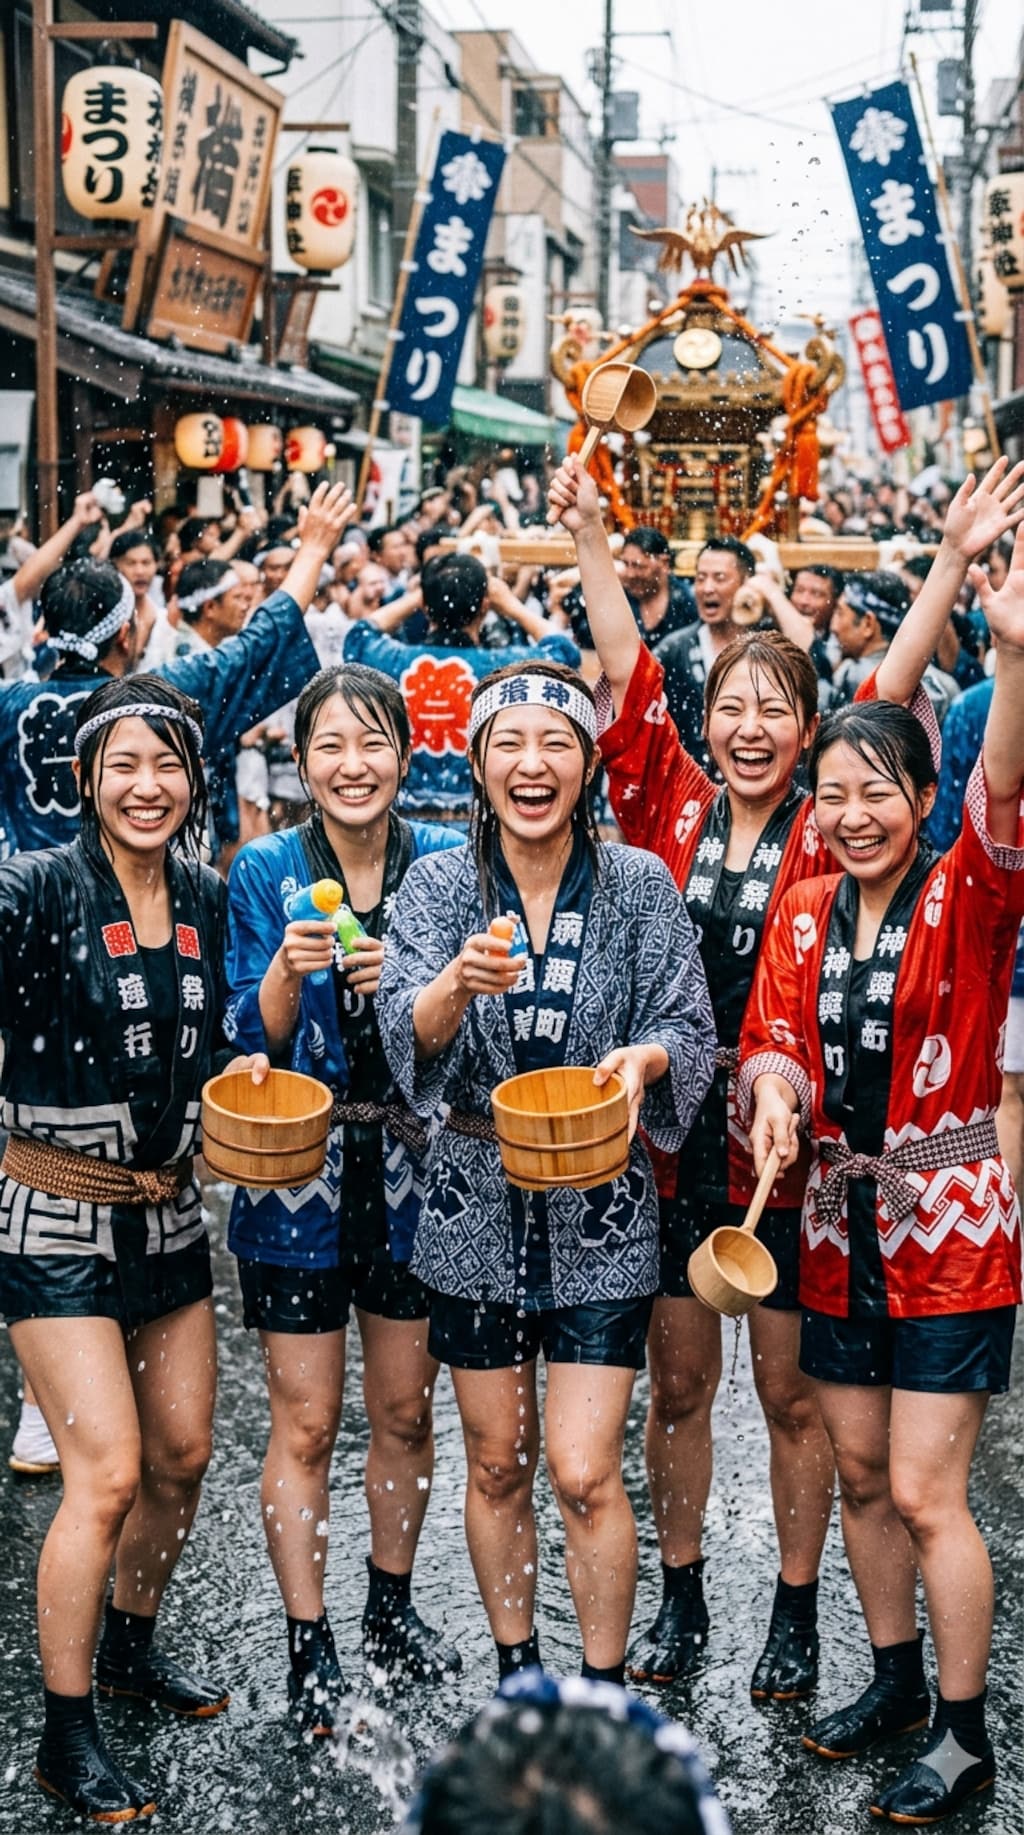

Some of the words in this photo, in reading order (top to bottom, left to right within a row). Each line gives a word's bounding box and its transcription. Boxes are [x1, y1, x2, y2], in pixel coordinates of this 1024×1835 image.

[82, 82, 129, 205] まつり
[180, 973, 206, 1059] 祭り
